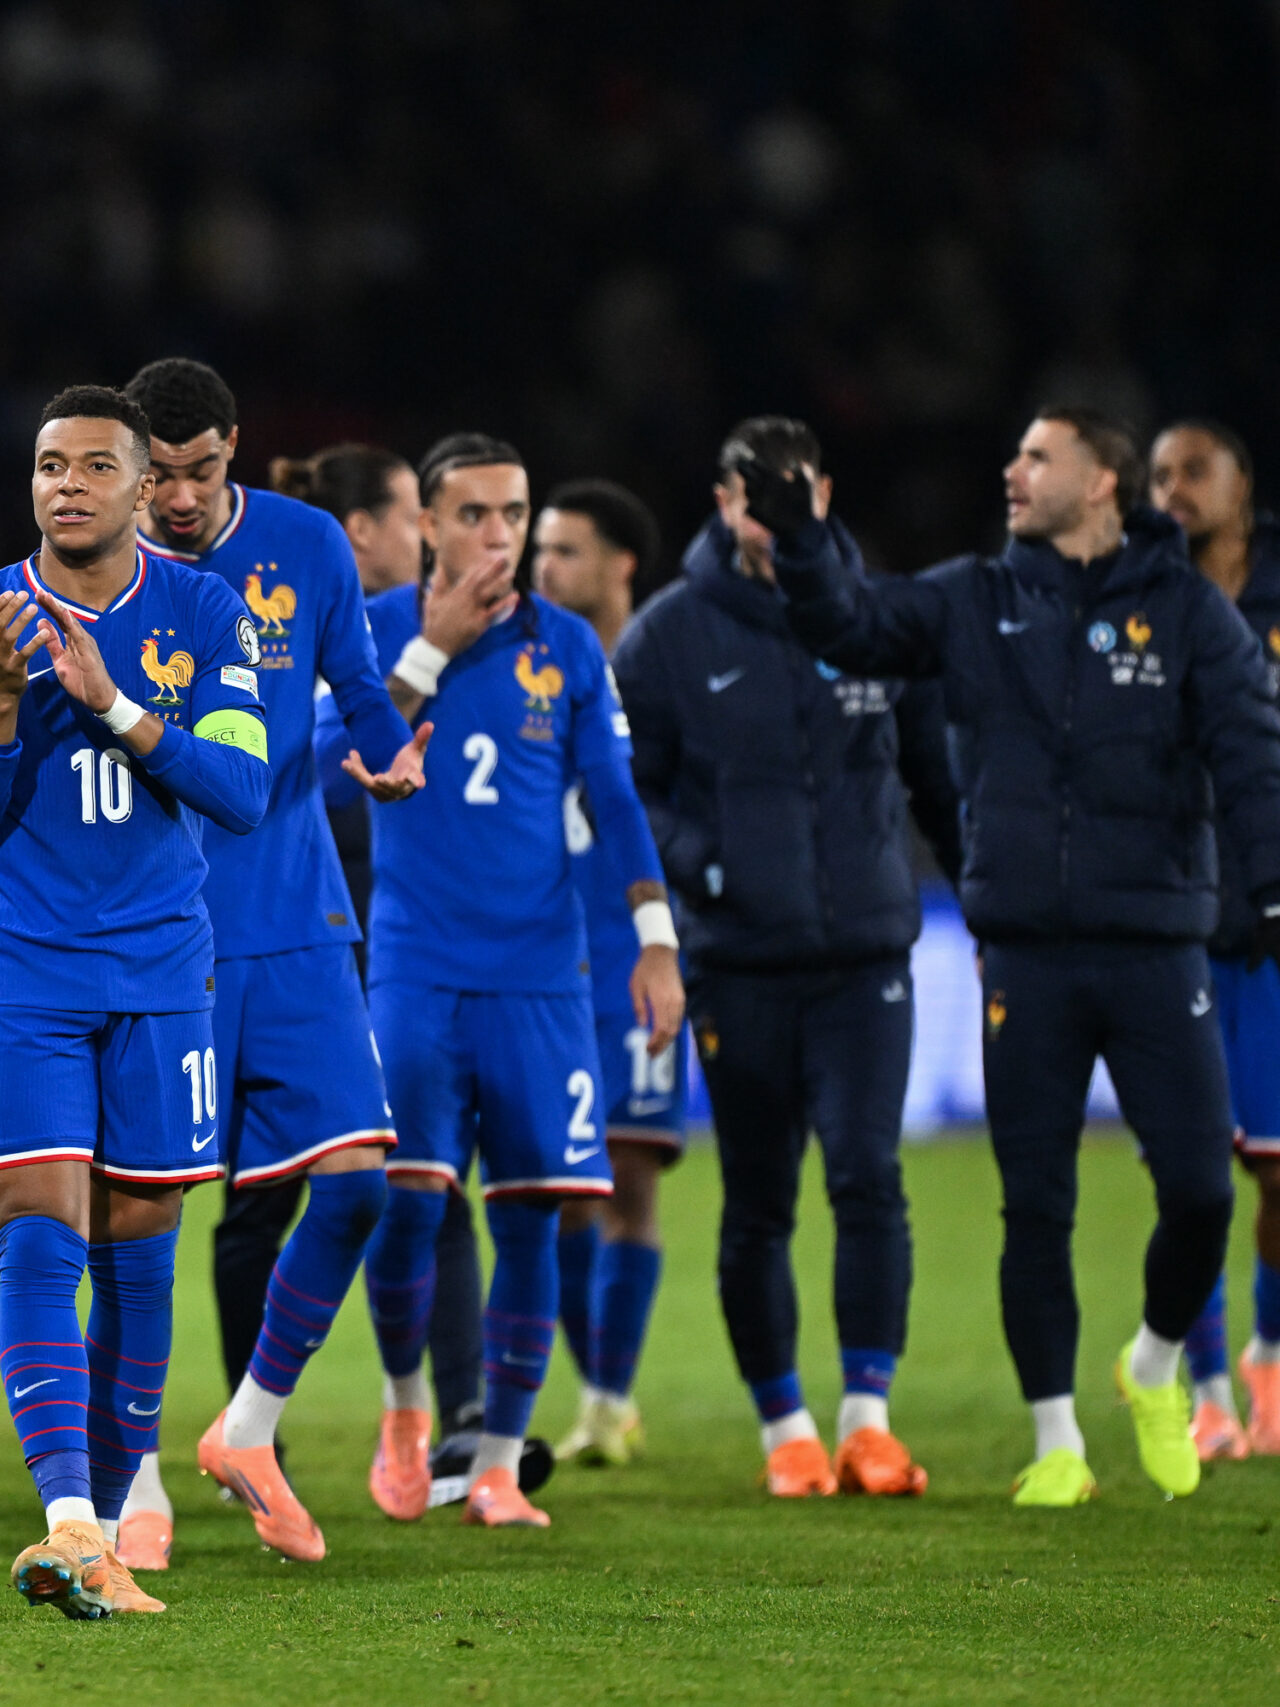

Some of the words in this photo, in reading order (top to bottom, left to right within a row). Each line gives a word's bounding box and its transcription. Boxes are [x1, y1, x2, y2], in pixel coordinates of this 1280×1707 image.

[69, 747, 133, 825] 10
[463, 733, 500, 805] 2
[181, 1046, 217, 1126] 10
[566, 1069, 597, 1141] 2
